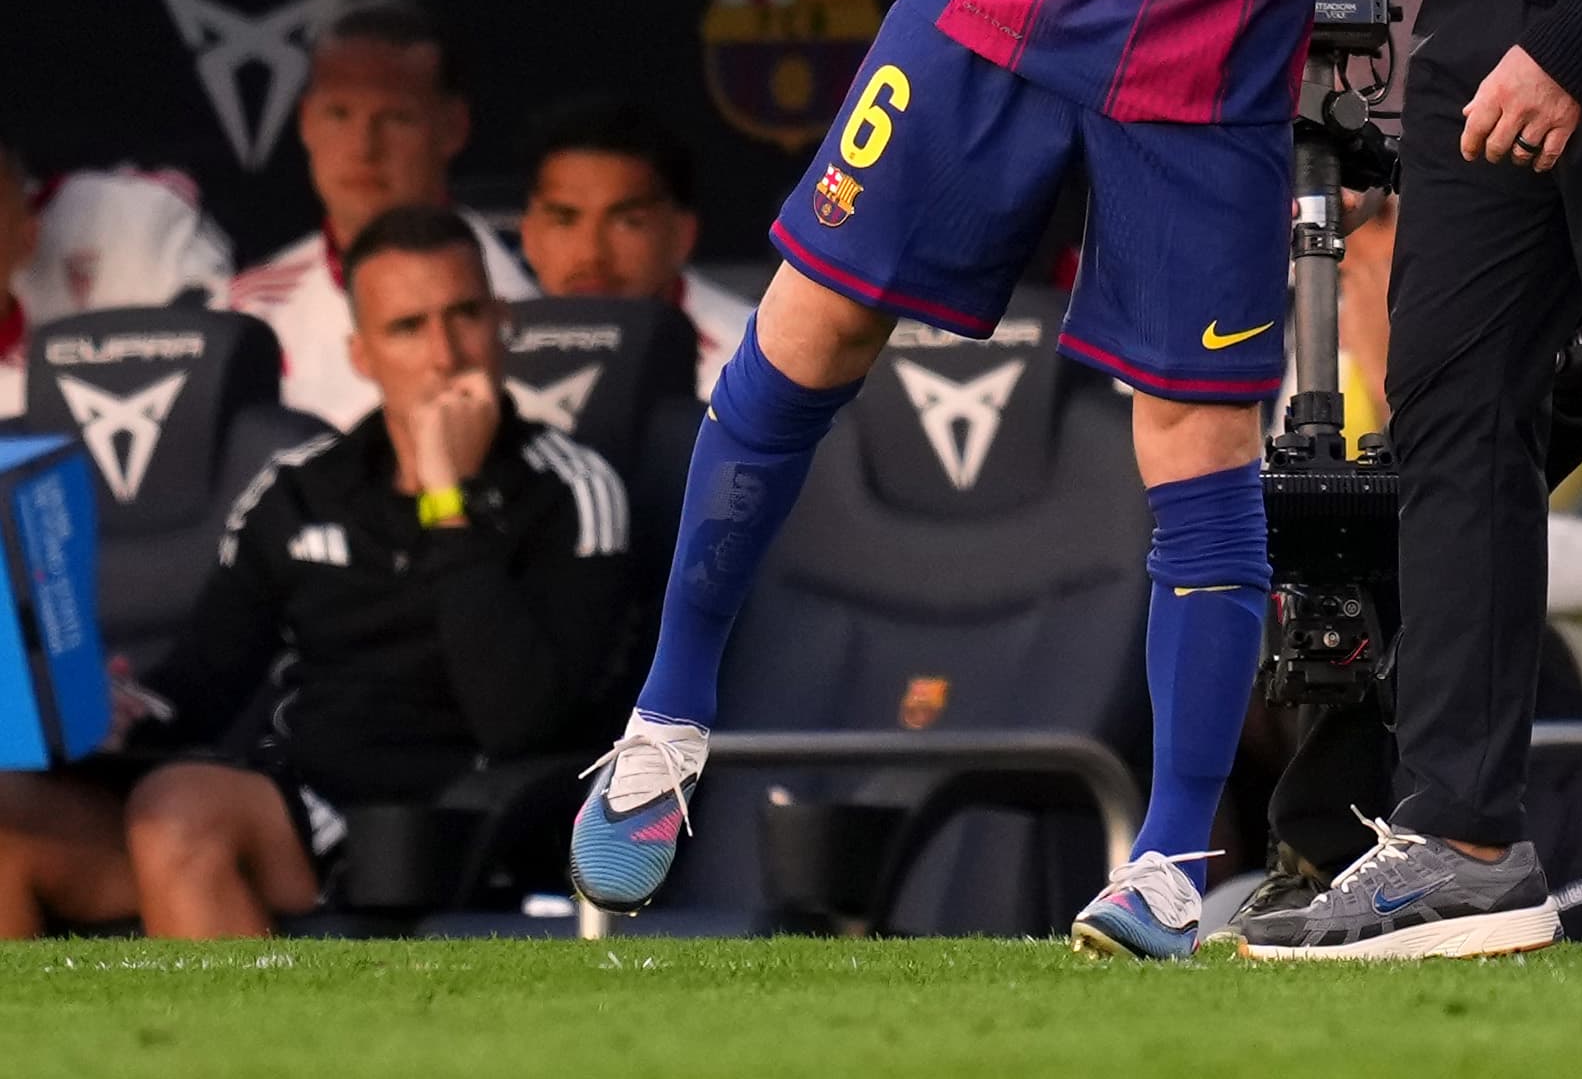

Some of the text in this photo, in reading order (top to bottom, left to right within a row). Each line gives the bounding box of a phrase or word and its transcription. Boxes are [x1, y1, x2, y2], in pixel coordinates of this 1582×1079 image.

[840, 64, 911, 169] 6
[46, 332, 205, 365] CUPRA
[499, 325, 622, 353] UPRA
